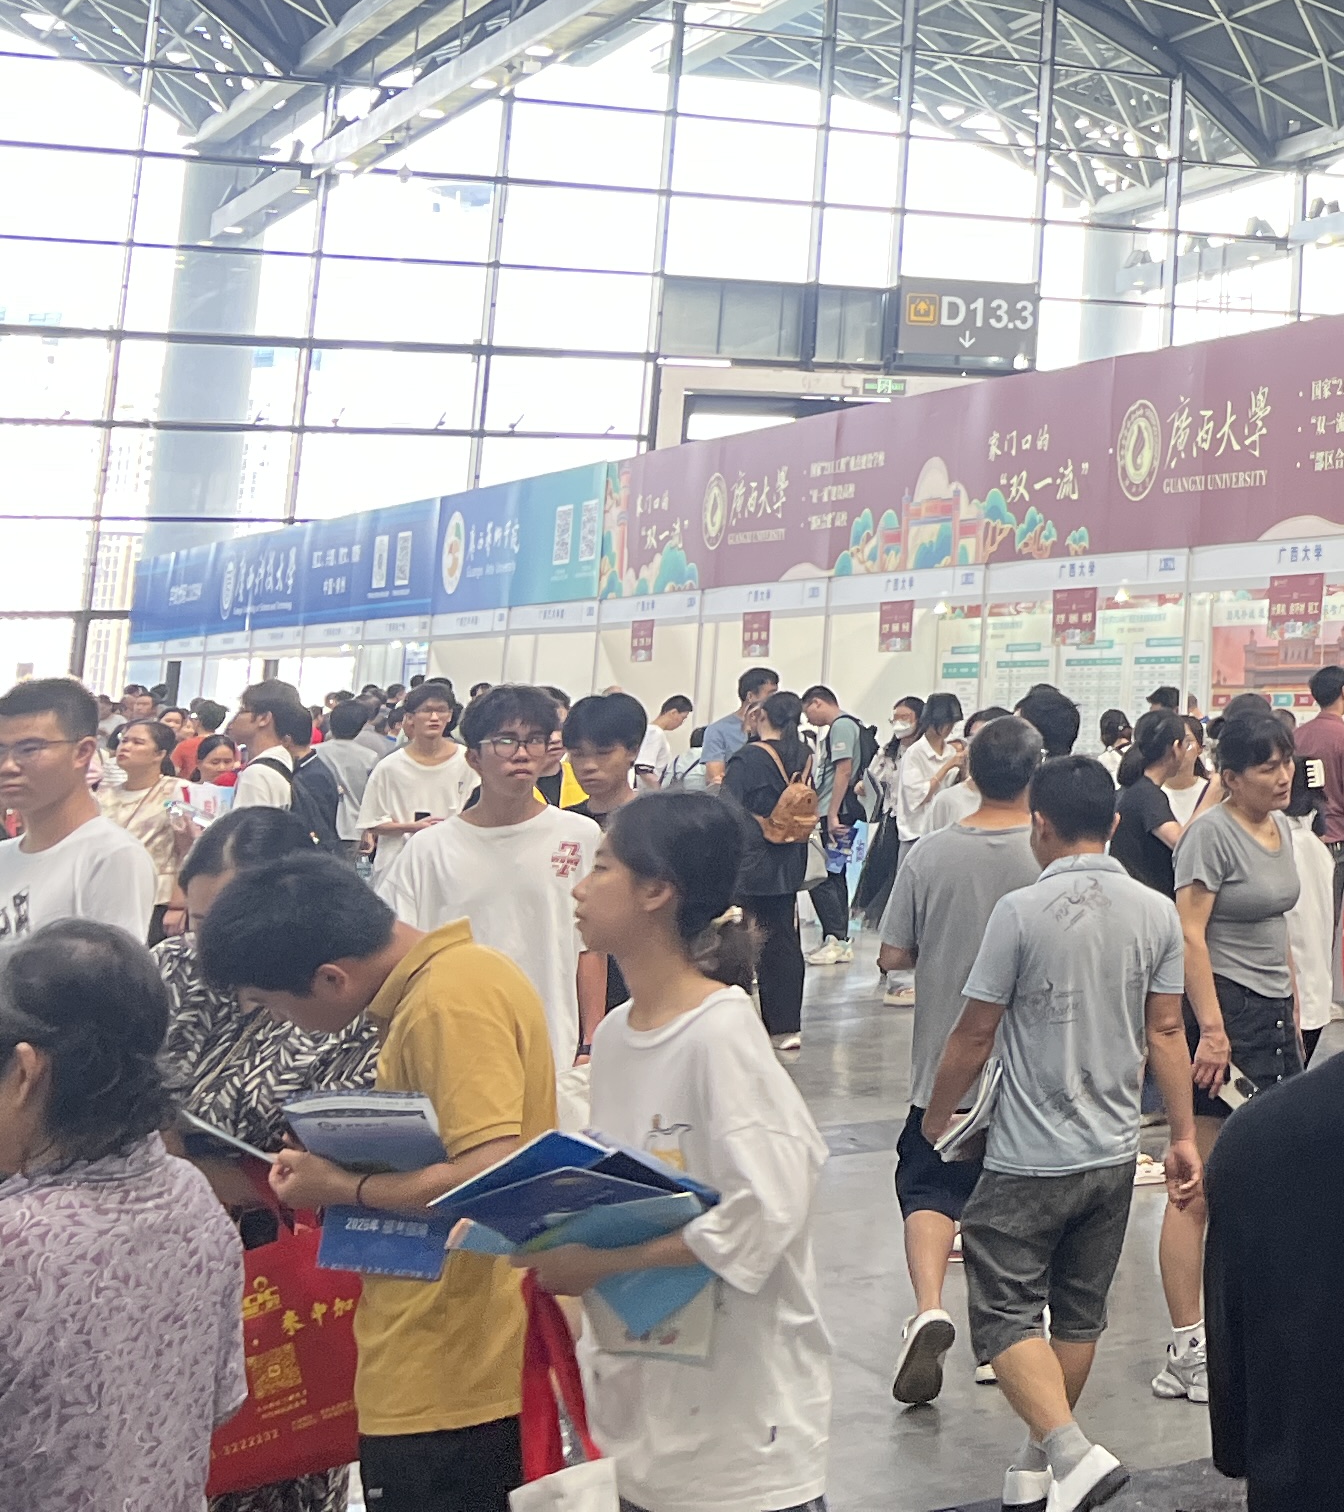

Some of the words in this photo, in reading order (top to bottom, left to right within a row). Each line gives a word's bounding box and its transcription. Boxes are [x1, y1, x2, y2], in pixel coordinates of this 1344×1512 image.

[940, 295, 1034, 330] D13.3
[1163, 472, 1206, 494] GUANGXI
[1207, 469, 1268, 491] UNIVERSITY
[1277, 544, 1323, 565] 广西大学
